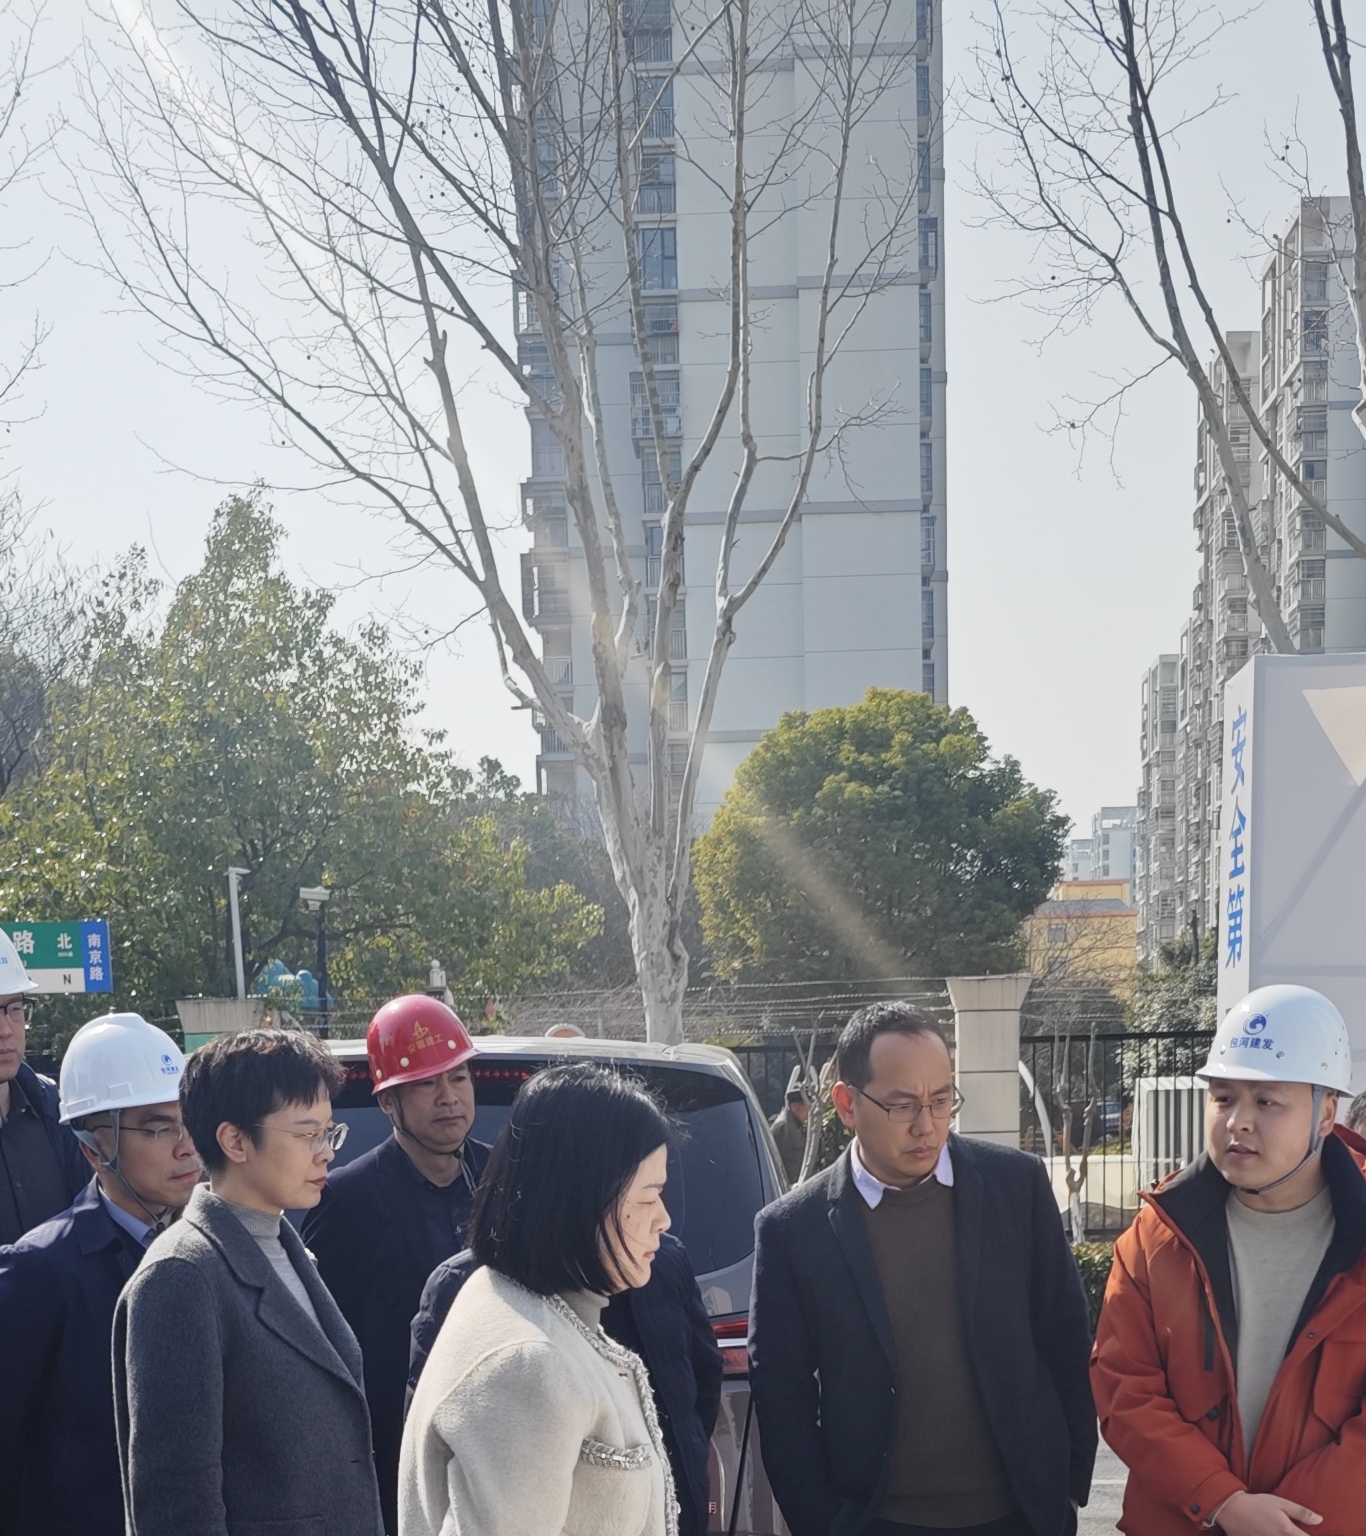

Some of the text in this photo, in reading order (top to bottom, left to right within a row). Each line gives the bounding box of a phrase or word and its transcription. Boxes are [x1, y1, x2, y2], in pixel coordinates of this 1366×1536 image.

[56, 933, 73, 950] 北
[87, 933, 104, 982] 南京路
[63, 973, 72, 985] N
[1230, 1036, 1275, 1051] 包河建发
